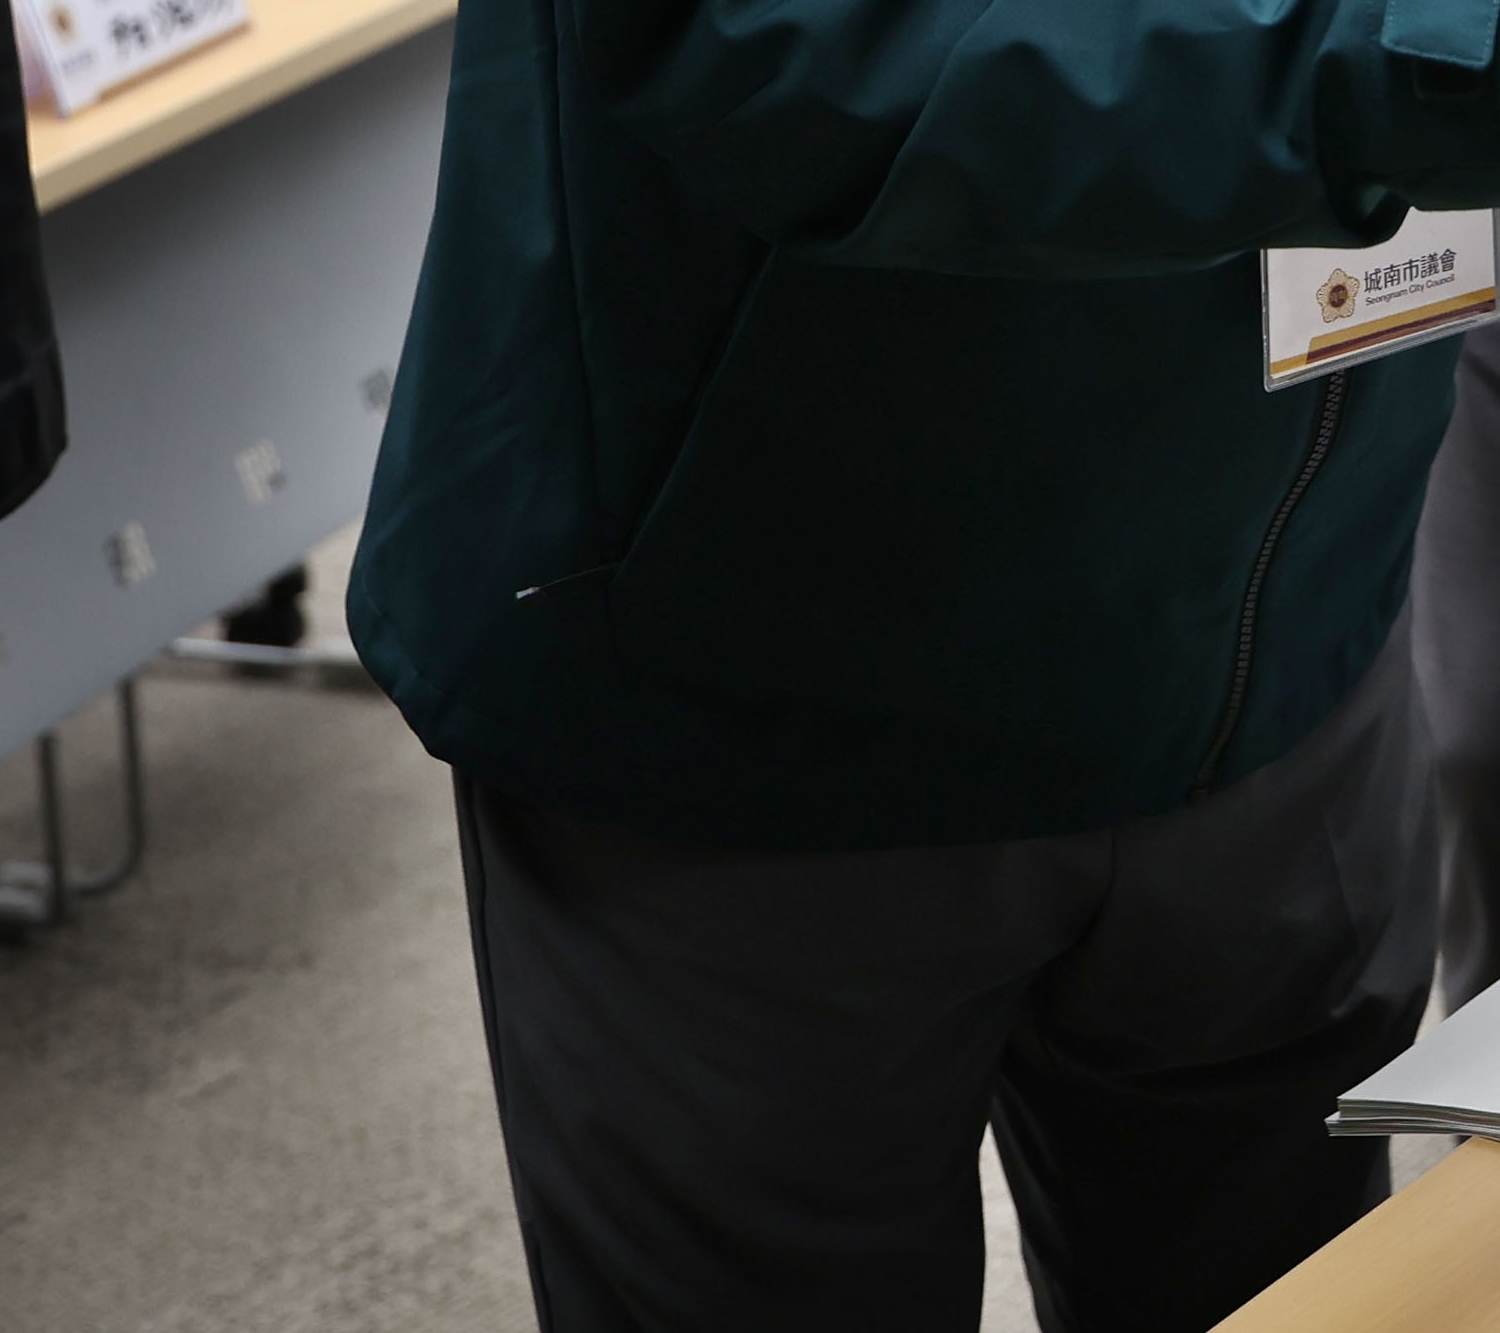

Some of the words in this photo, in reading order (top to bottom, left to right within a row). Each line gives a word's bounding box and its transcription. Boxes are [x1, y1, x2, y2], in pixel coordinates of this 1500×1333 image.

[1363, 248, 1457, 293] 城南市議會
[1365, 289, 1408, 306] Seongnam
[1409, 283, 1425, 294] City
[1426, 273, 1455, 289] Council
